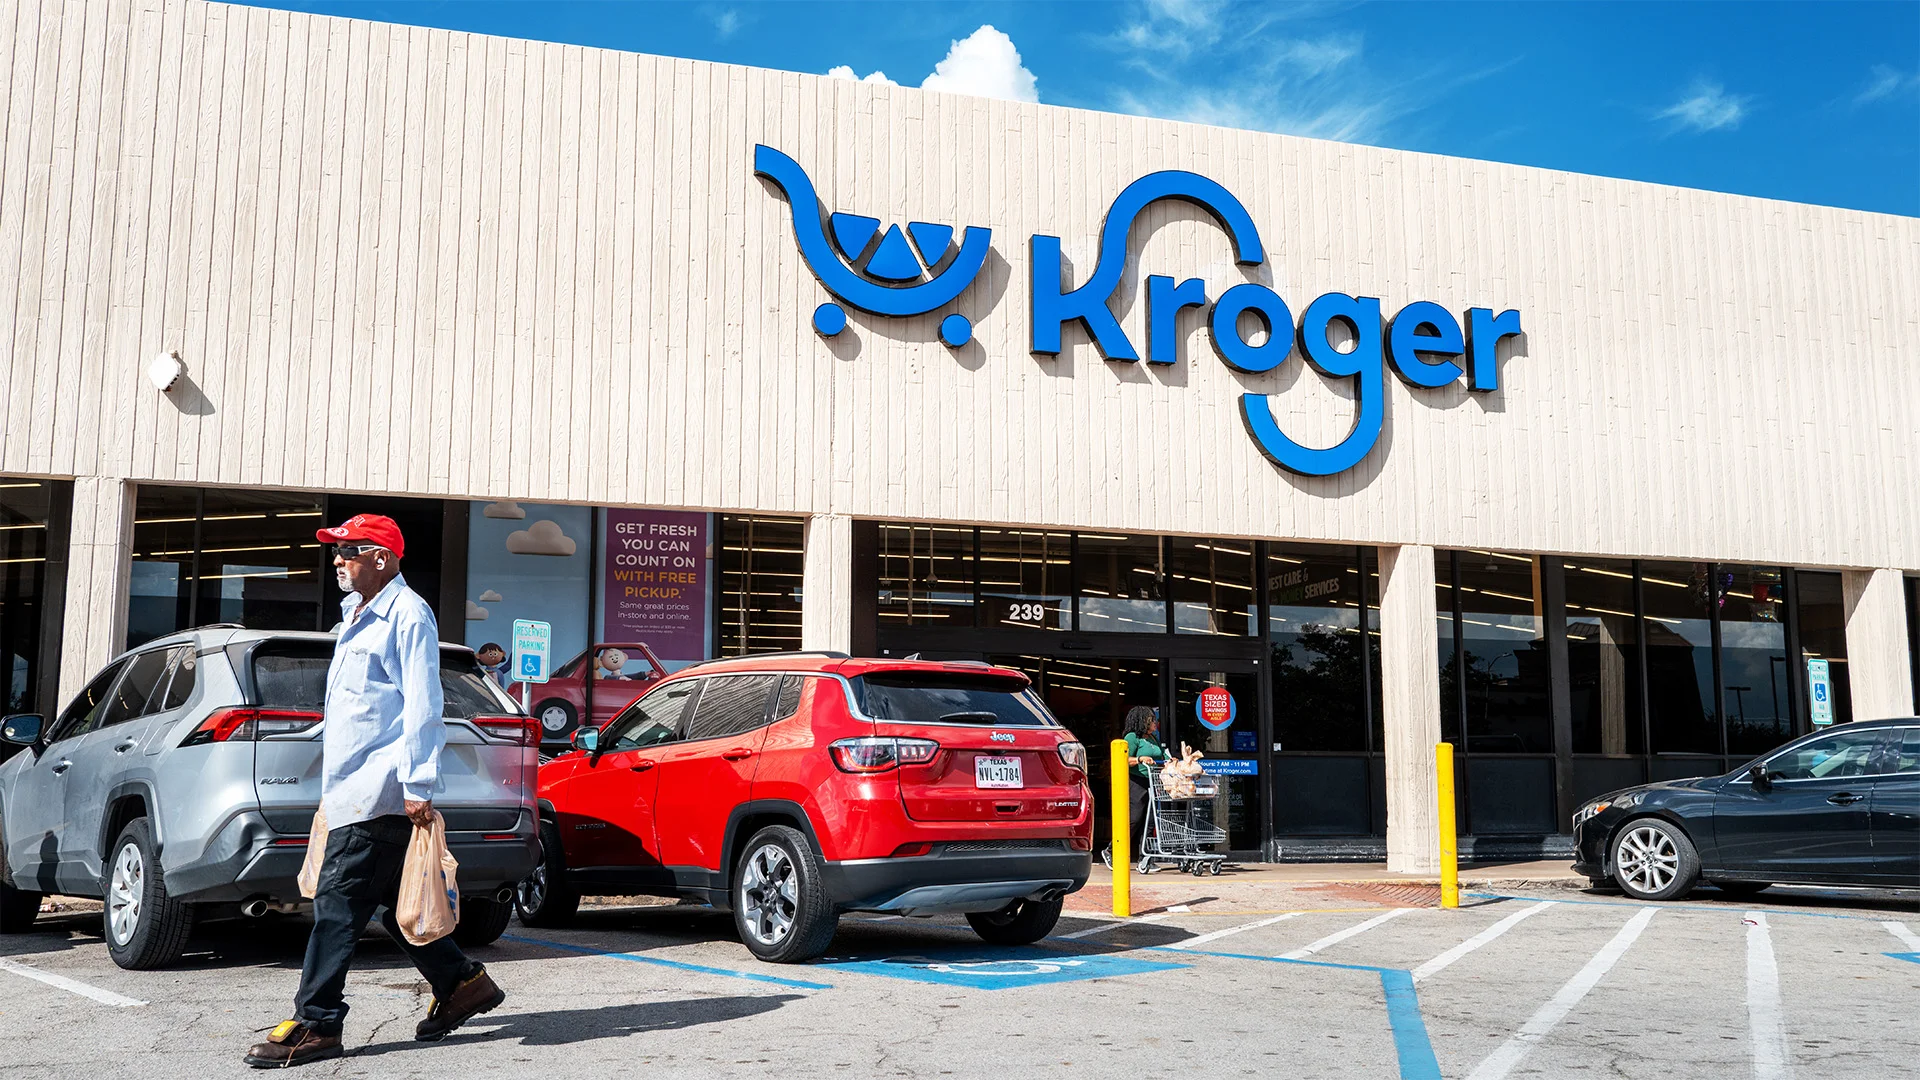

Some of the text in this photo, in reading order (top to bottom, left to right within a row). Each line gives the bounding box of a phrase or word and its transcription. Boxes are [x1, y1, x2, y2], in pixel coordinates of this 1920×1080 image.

[1029, 170, 1521, 477] Kroger
[615, 522, 698, 536] GET FRESH
[622, 538, 690, 552] YOU CAN
[615, 554, 695, 568] COUNT ON
[614, 570, 697, 584] WITH FREE
[1283, 569, 1302, 587] CARE
[1304, 577, 1340, 599] SERVICES
[619, 601, 690, 612] Same great prices
[1009, 603, 1044, 621] 239
[617, 611, 691, 621] in-store and online.
[516, 625, 548, 638] RESERVED
[518, 639, 545, 651] PARKING
[990, 731, 1015, 743] Jeep
